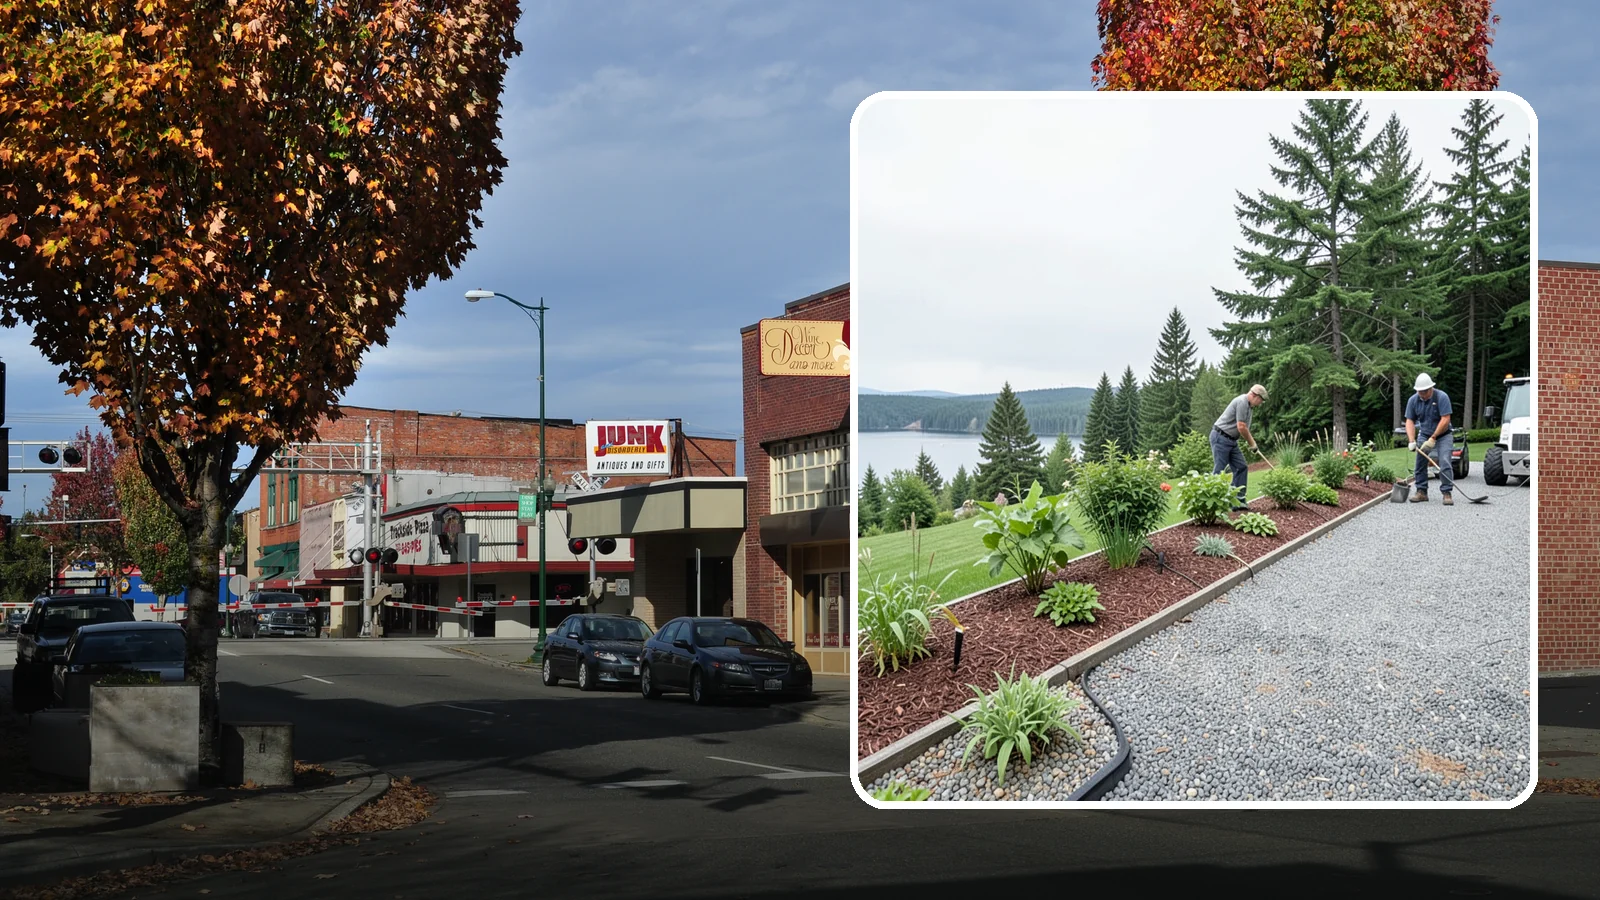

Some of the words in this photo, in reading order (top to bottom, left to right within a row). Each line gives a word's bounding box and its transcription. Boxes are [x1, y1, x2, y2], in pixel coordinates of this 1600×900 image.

[595, 425, 665, 457] JUNK
[607, 446, 646, 454] DISORDERLY
[596, 461, 628, 470] ANTIQUES
[631, 461, 644, 470] AND
[646, 460, 665, 470] GIFTS
[414, 519, 429, 535] Pizza
